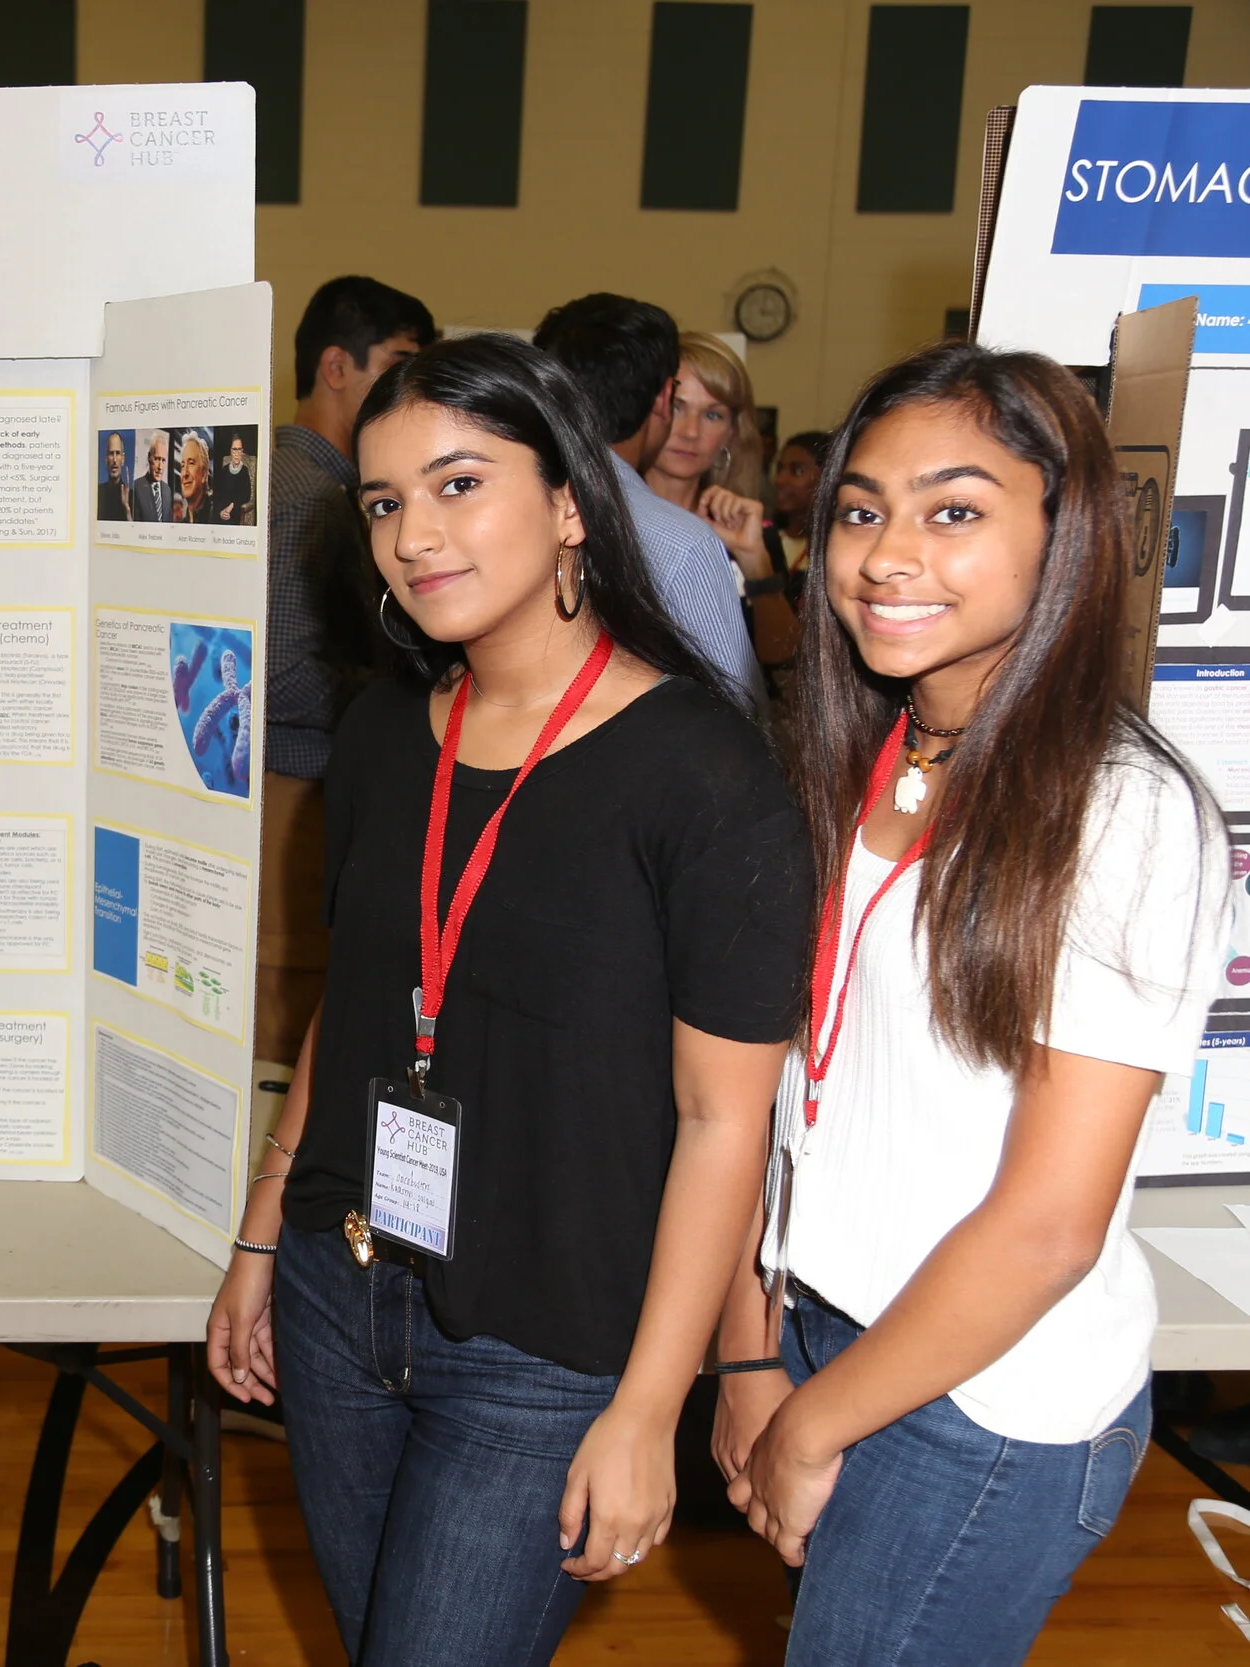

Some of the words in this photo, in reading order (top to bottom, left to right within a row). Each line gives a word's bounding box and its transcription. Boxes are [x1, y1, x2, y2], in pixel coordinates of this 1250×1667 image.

[130, 111, 208, 127] BREAST
[130, 130, 215, 146] CANCER
[130, 151, 174, 166] HUB
[106, 403, 133, 413] Famous
[134, 401, 159, 414] Figures
[161, 400, 175, 410] with
[177, 397, 217, 409] Pancreatic
[219, 396, 248, 407] Cancer
[130, 622, 164, 633] Pancreatic
[0, 633, 49, 645] (chemo)
[1196, 669, 1245, 677] Introduction
[409, 1117, 445, 1137] BREAST
[408, 1130, 447, 1150] CANCER
[408, 1141, 427, 1155] HUB
[375, 1209, 439, 1246] PARTICIPANT
